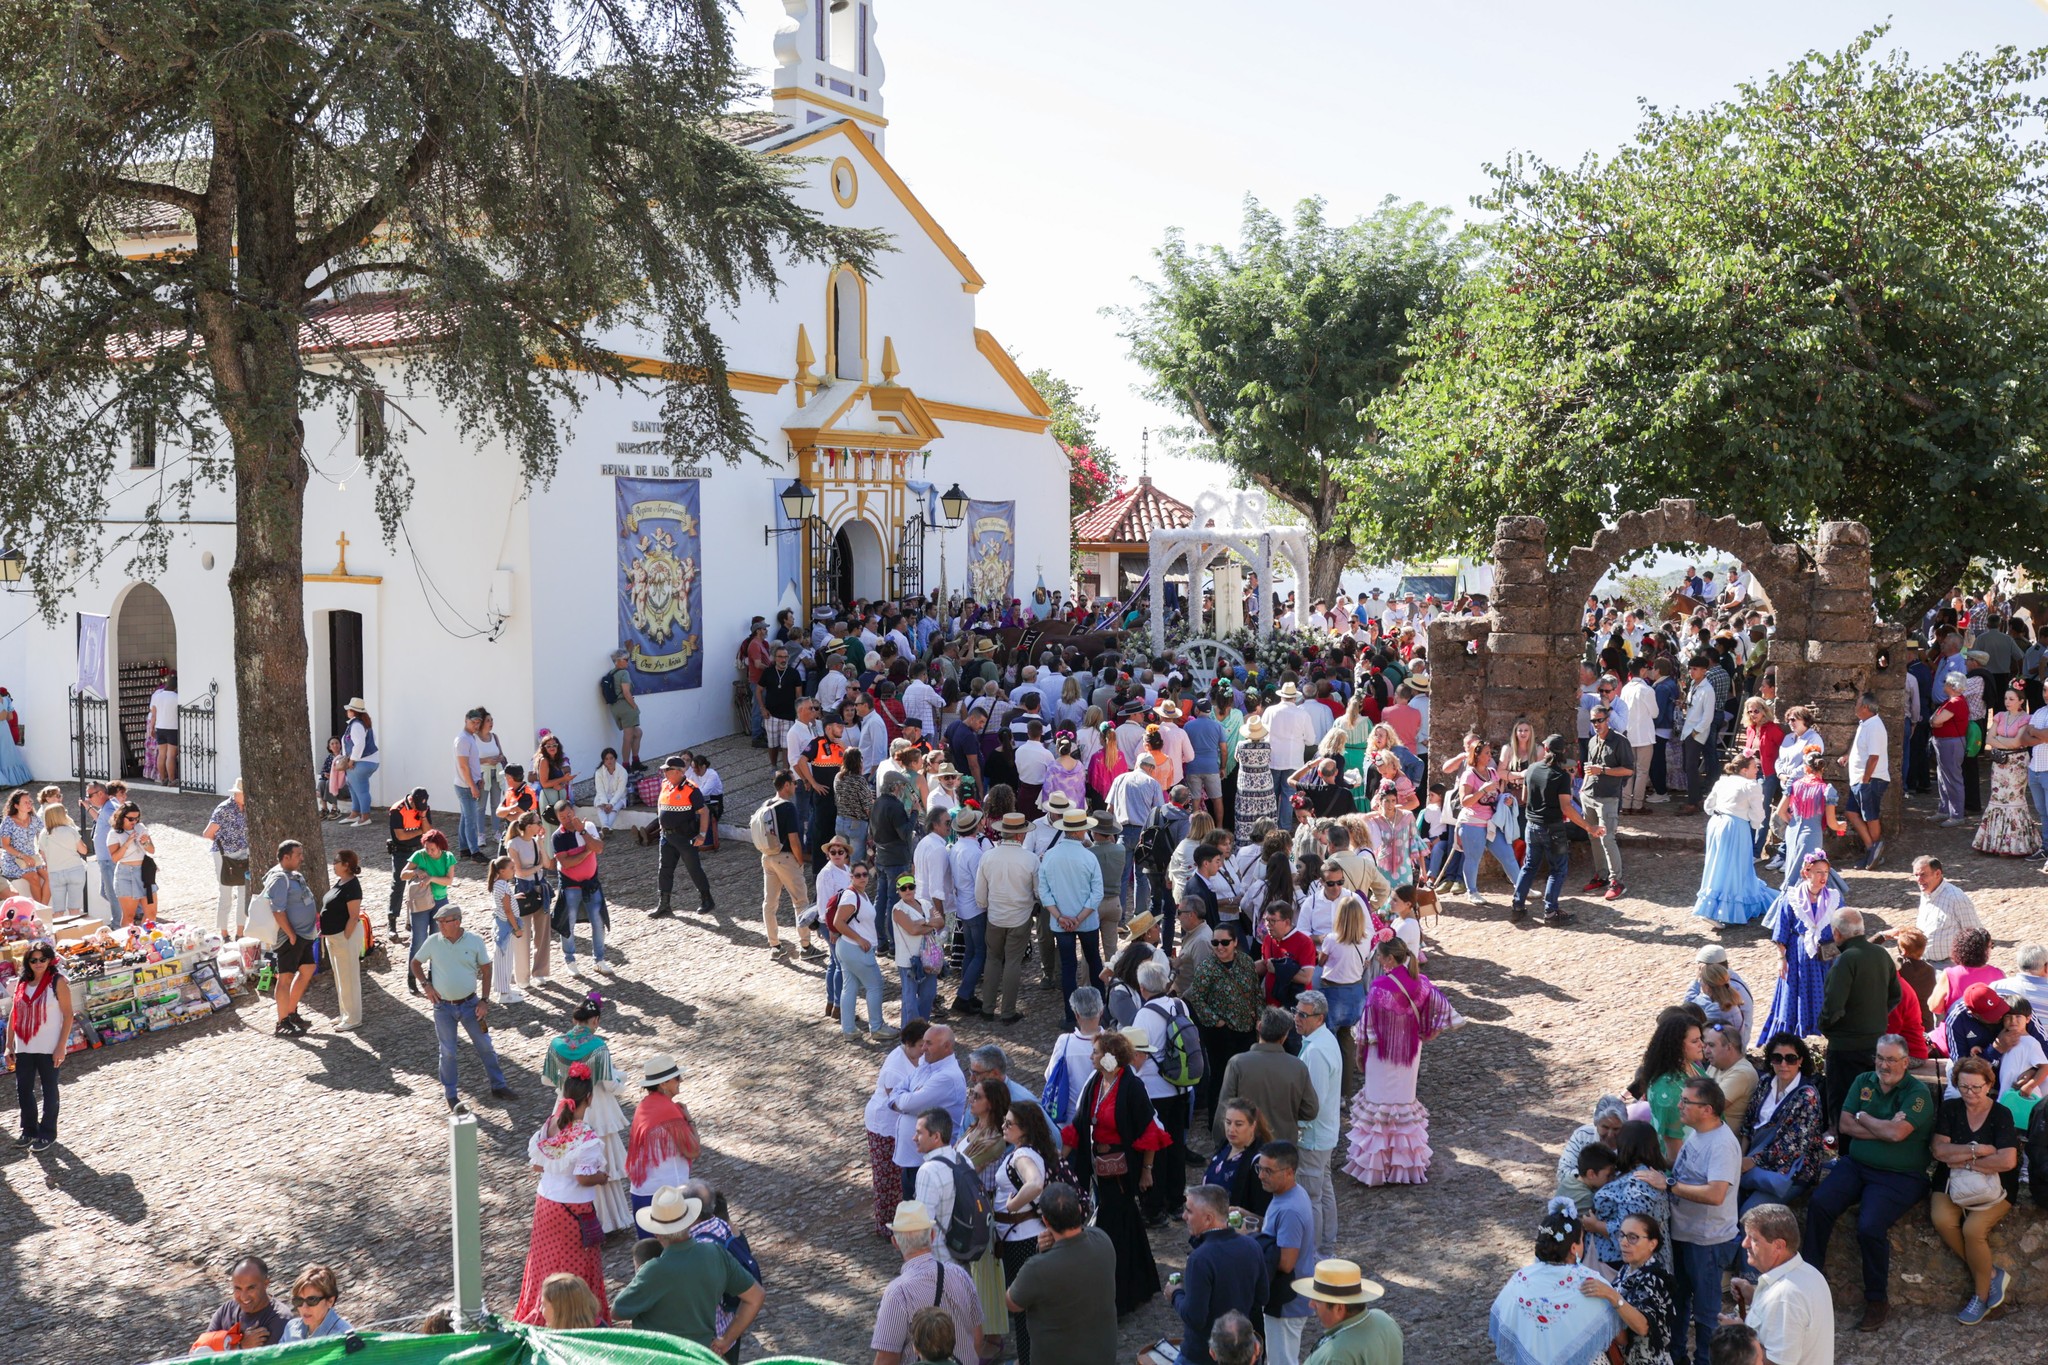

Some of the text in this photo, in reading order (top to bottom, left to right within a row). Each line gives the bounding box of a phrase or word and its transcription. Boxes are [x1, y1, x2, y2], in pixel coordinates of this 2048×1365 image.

[602, 464, 631, 476] REINA
[636, 465, 648, 476] DE
[653, 466, 670, 478] LOS
[1912, 1097, 1925, 1113] 3
